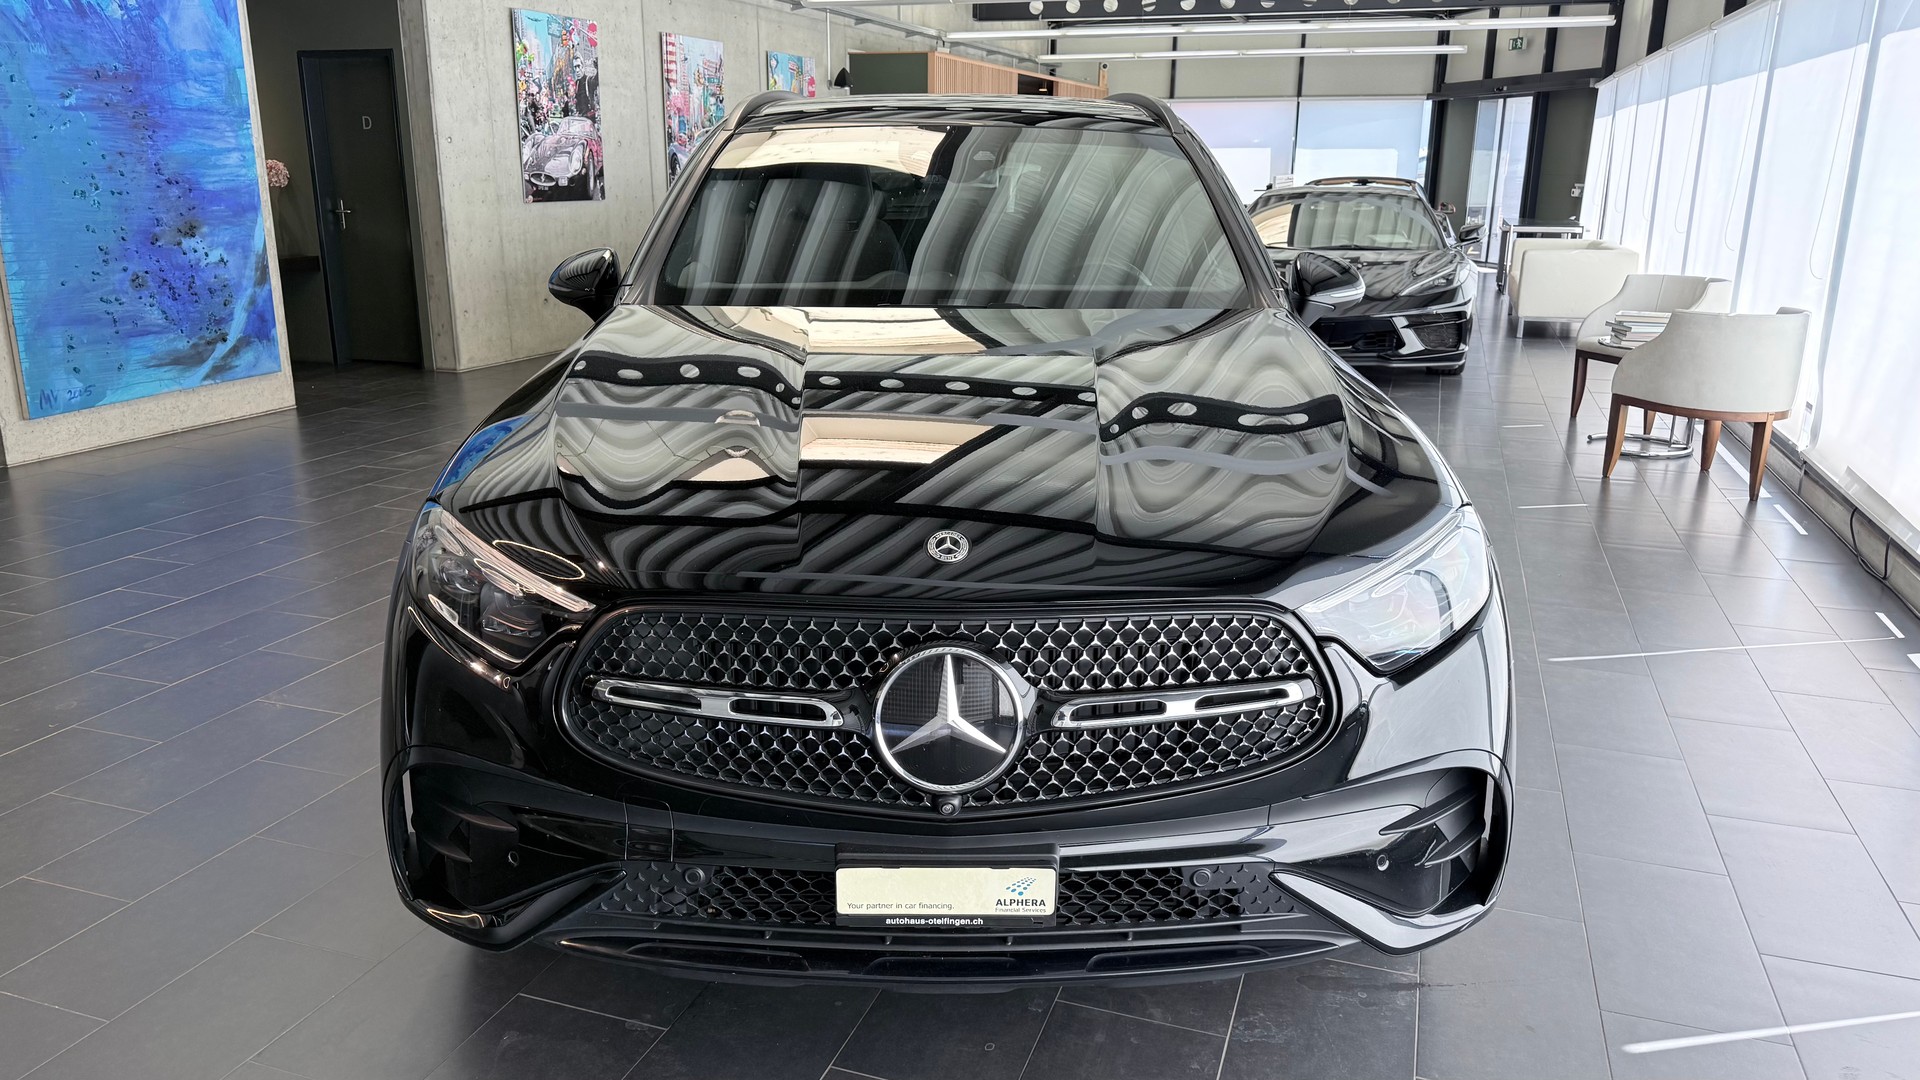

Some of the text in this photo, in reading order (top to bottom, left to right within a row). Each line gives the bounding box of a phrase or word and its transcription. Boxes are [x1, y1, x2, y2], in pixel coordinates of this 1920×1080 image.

[362, 115, 372, 130] D
[866, 902, 893, 910] partner
[918, 902, 955, 910] financing.
[995, 898, 1046, 907] ALPHERA
[885, 917, 983, 926] autohaus-otelfingen.ch
